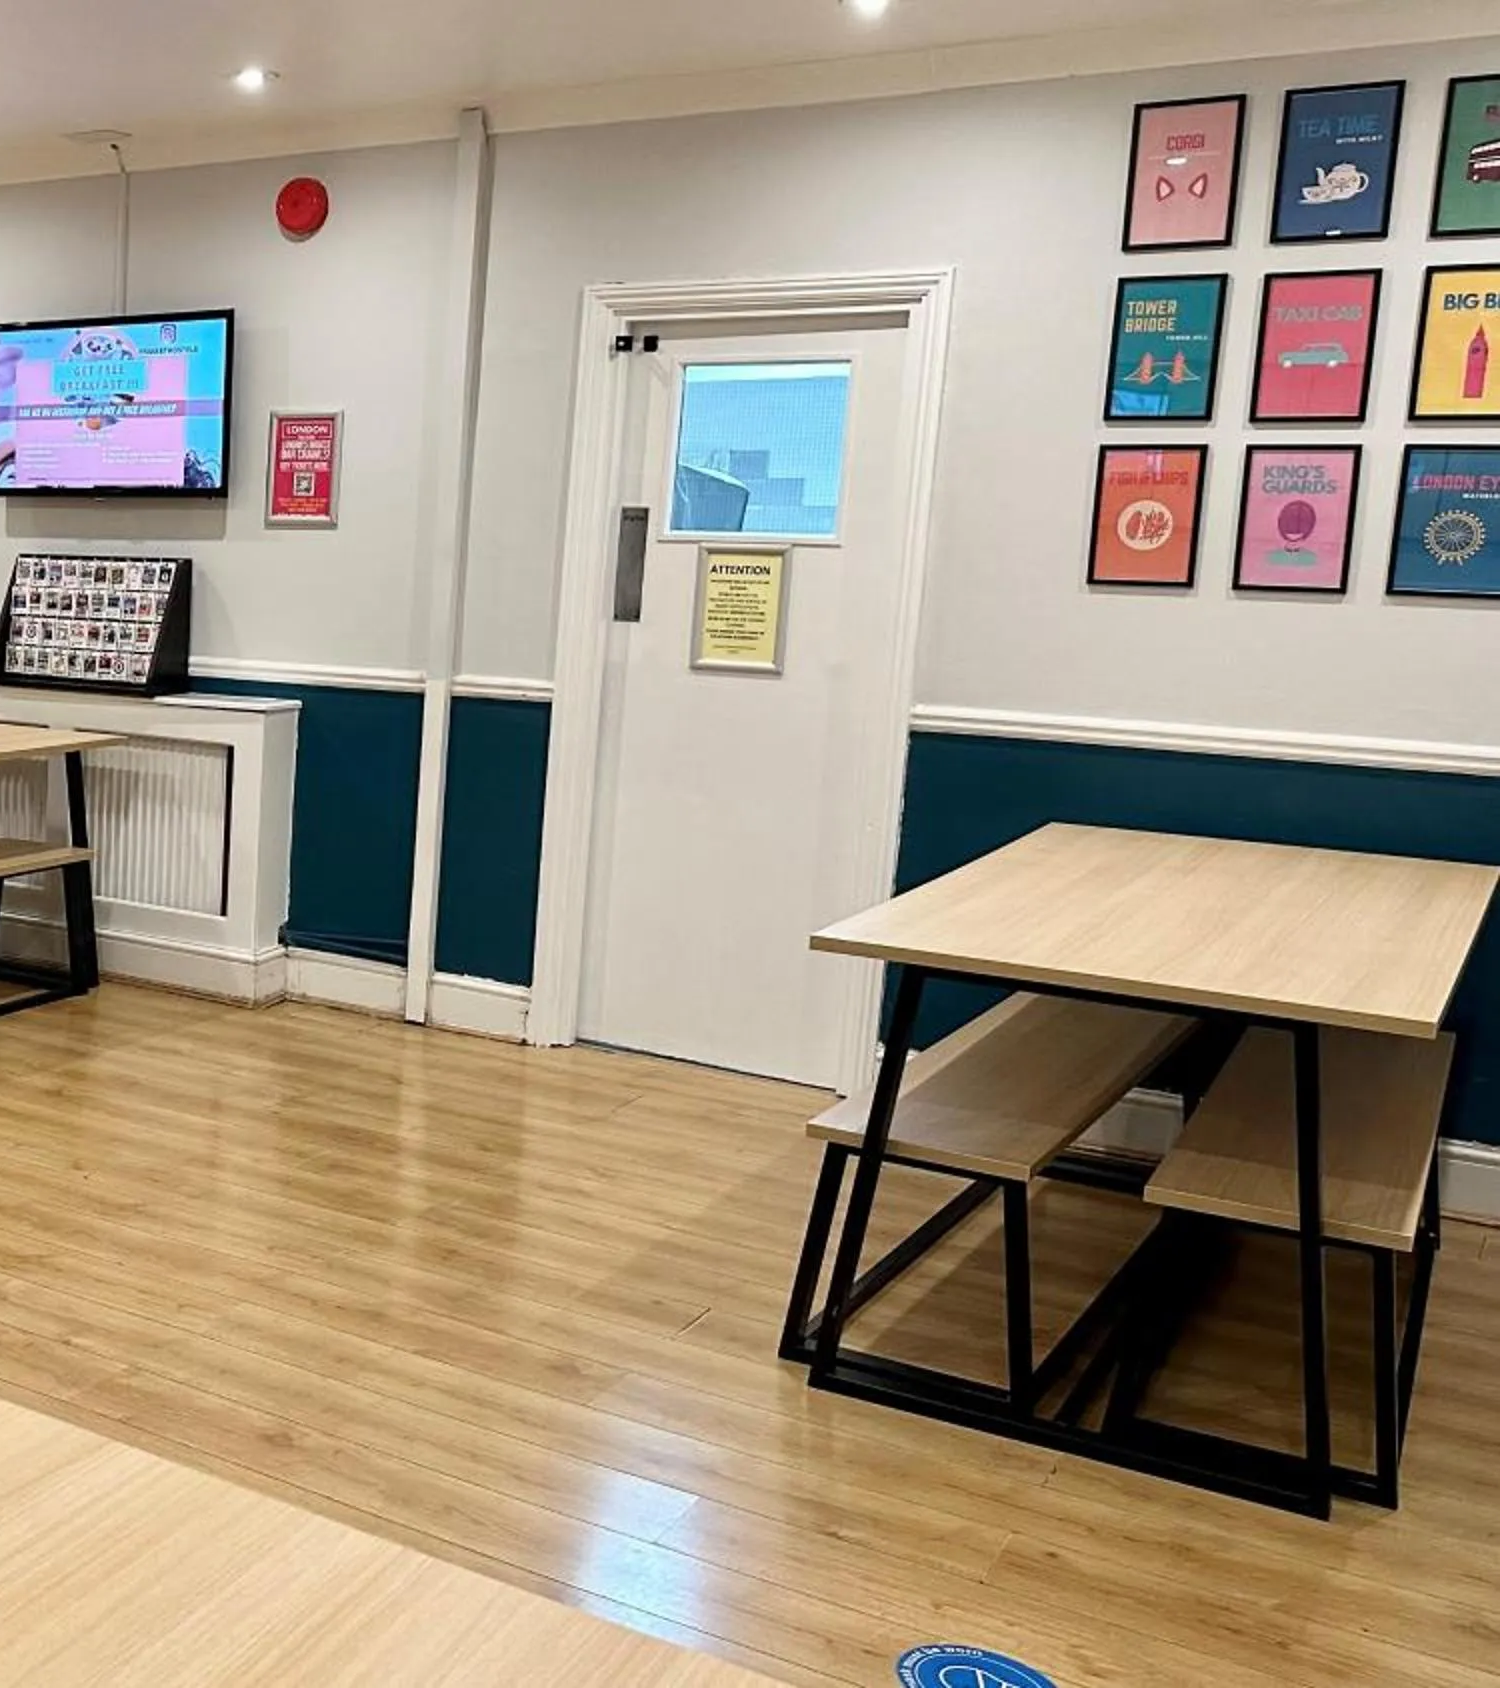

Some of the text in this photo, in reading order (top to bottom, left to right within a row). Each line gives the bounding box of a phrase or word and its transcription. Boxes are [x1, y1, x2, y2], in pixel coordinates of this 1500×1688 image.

[1299, 114, 1380, 138] TEA TIME
[1165, 134, 1205, 151] CORGI
[1127, 300, 1178, 316] TOWER
[1443, 293, 1500, 310] BIG B
[1277, 304, 1364, 322] TAXI CAB
[1124, 317, 1177, 333] BRIDGE
[73, 366, 94, 376] GET
[285, 425, 329, 435] LONDON
[1263, 464, 1325, 479] KING'S
[1262, 480, 1338, 494] GUARDS
[1412, 473, 1500, 490] LONDON EY
[710, 565, 771, 576] ATTENTION
